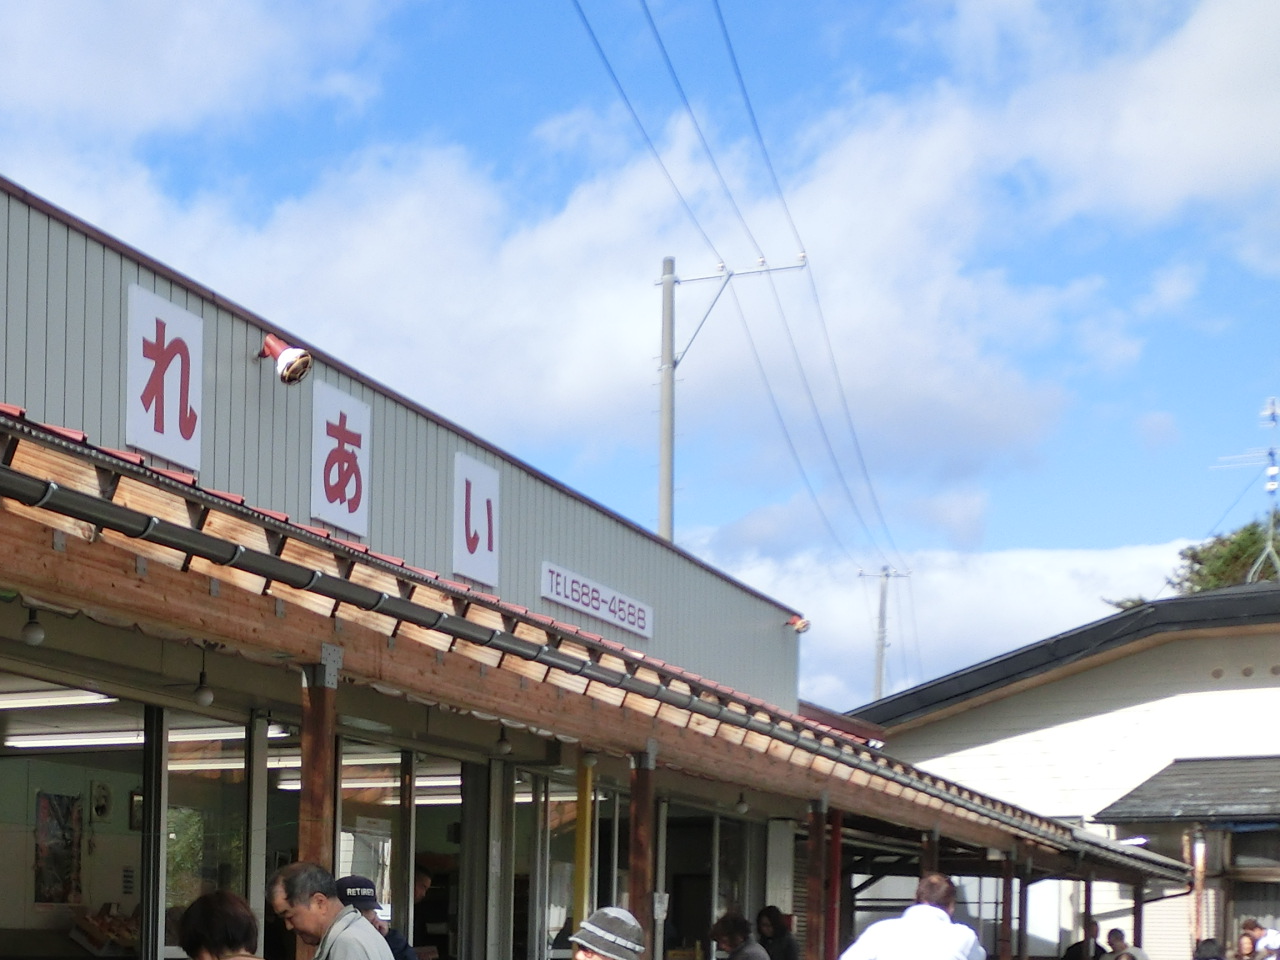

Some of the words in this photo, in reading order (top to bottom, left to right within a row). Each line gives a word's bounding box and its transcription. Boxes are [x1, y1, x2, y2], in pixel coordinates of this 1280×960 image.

[140, 318, 199, 441] れ
[323, 412, 363, 514] あ
[464, 478, 494, 556] い
[548, 568, 646, 630] TEL688-4588
[346, 887, 375, 897] RETIRED
